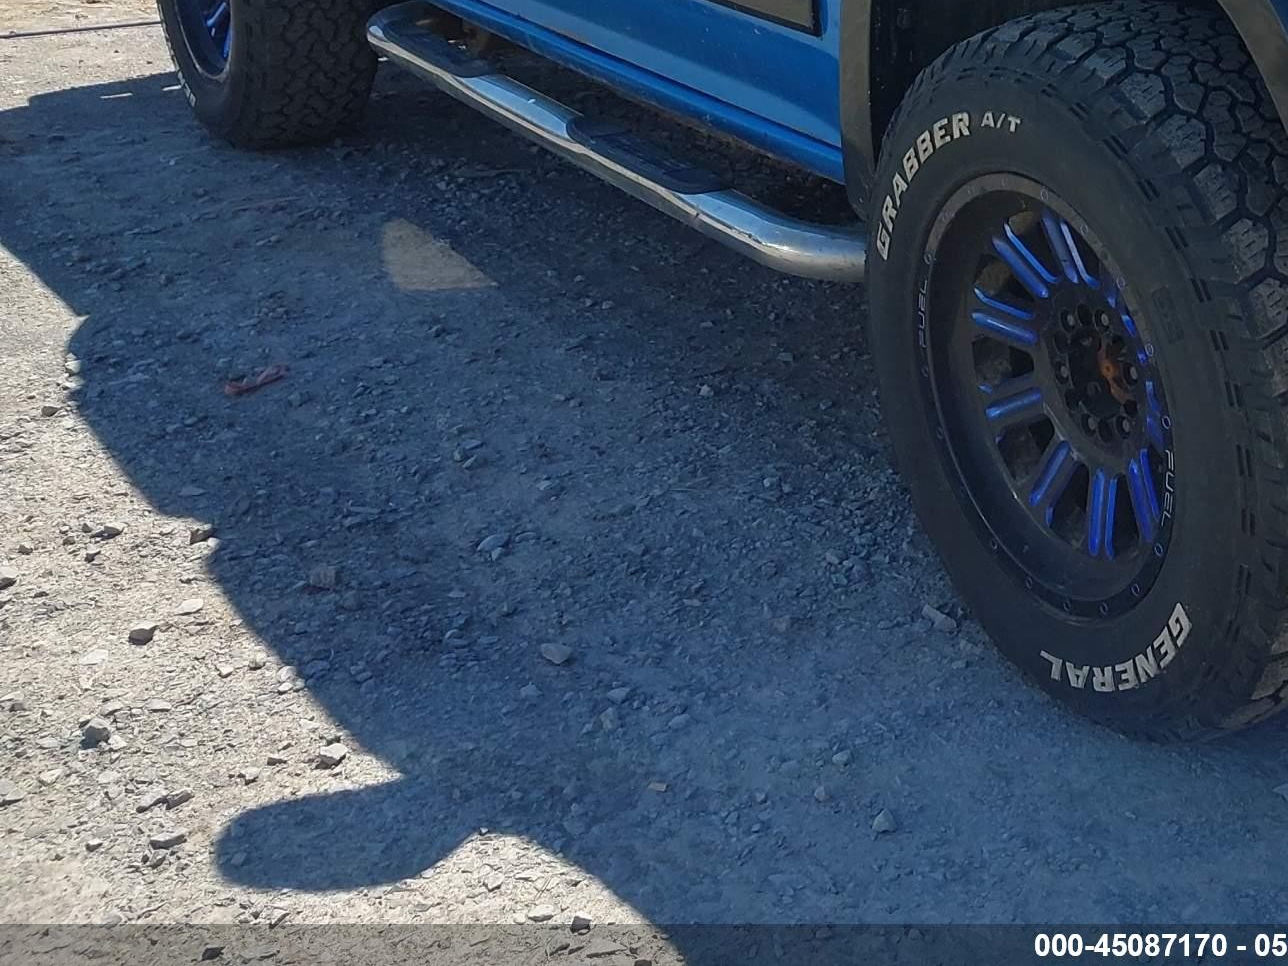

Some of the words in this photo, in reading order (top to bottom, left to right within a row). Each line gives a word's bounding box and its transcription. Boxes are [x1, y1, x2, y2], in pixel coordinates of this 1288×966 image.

[876, 112, 970, 261] GRABBER
[980, 110, 1022, 133] A/T
[918, 279, 928, 348] FUEL
[1161, 449, 1175, 527] FUEL
[1039, 602, 1193, 693] GENERAL
